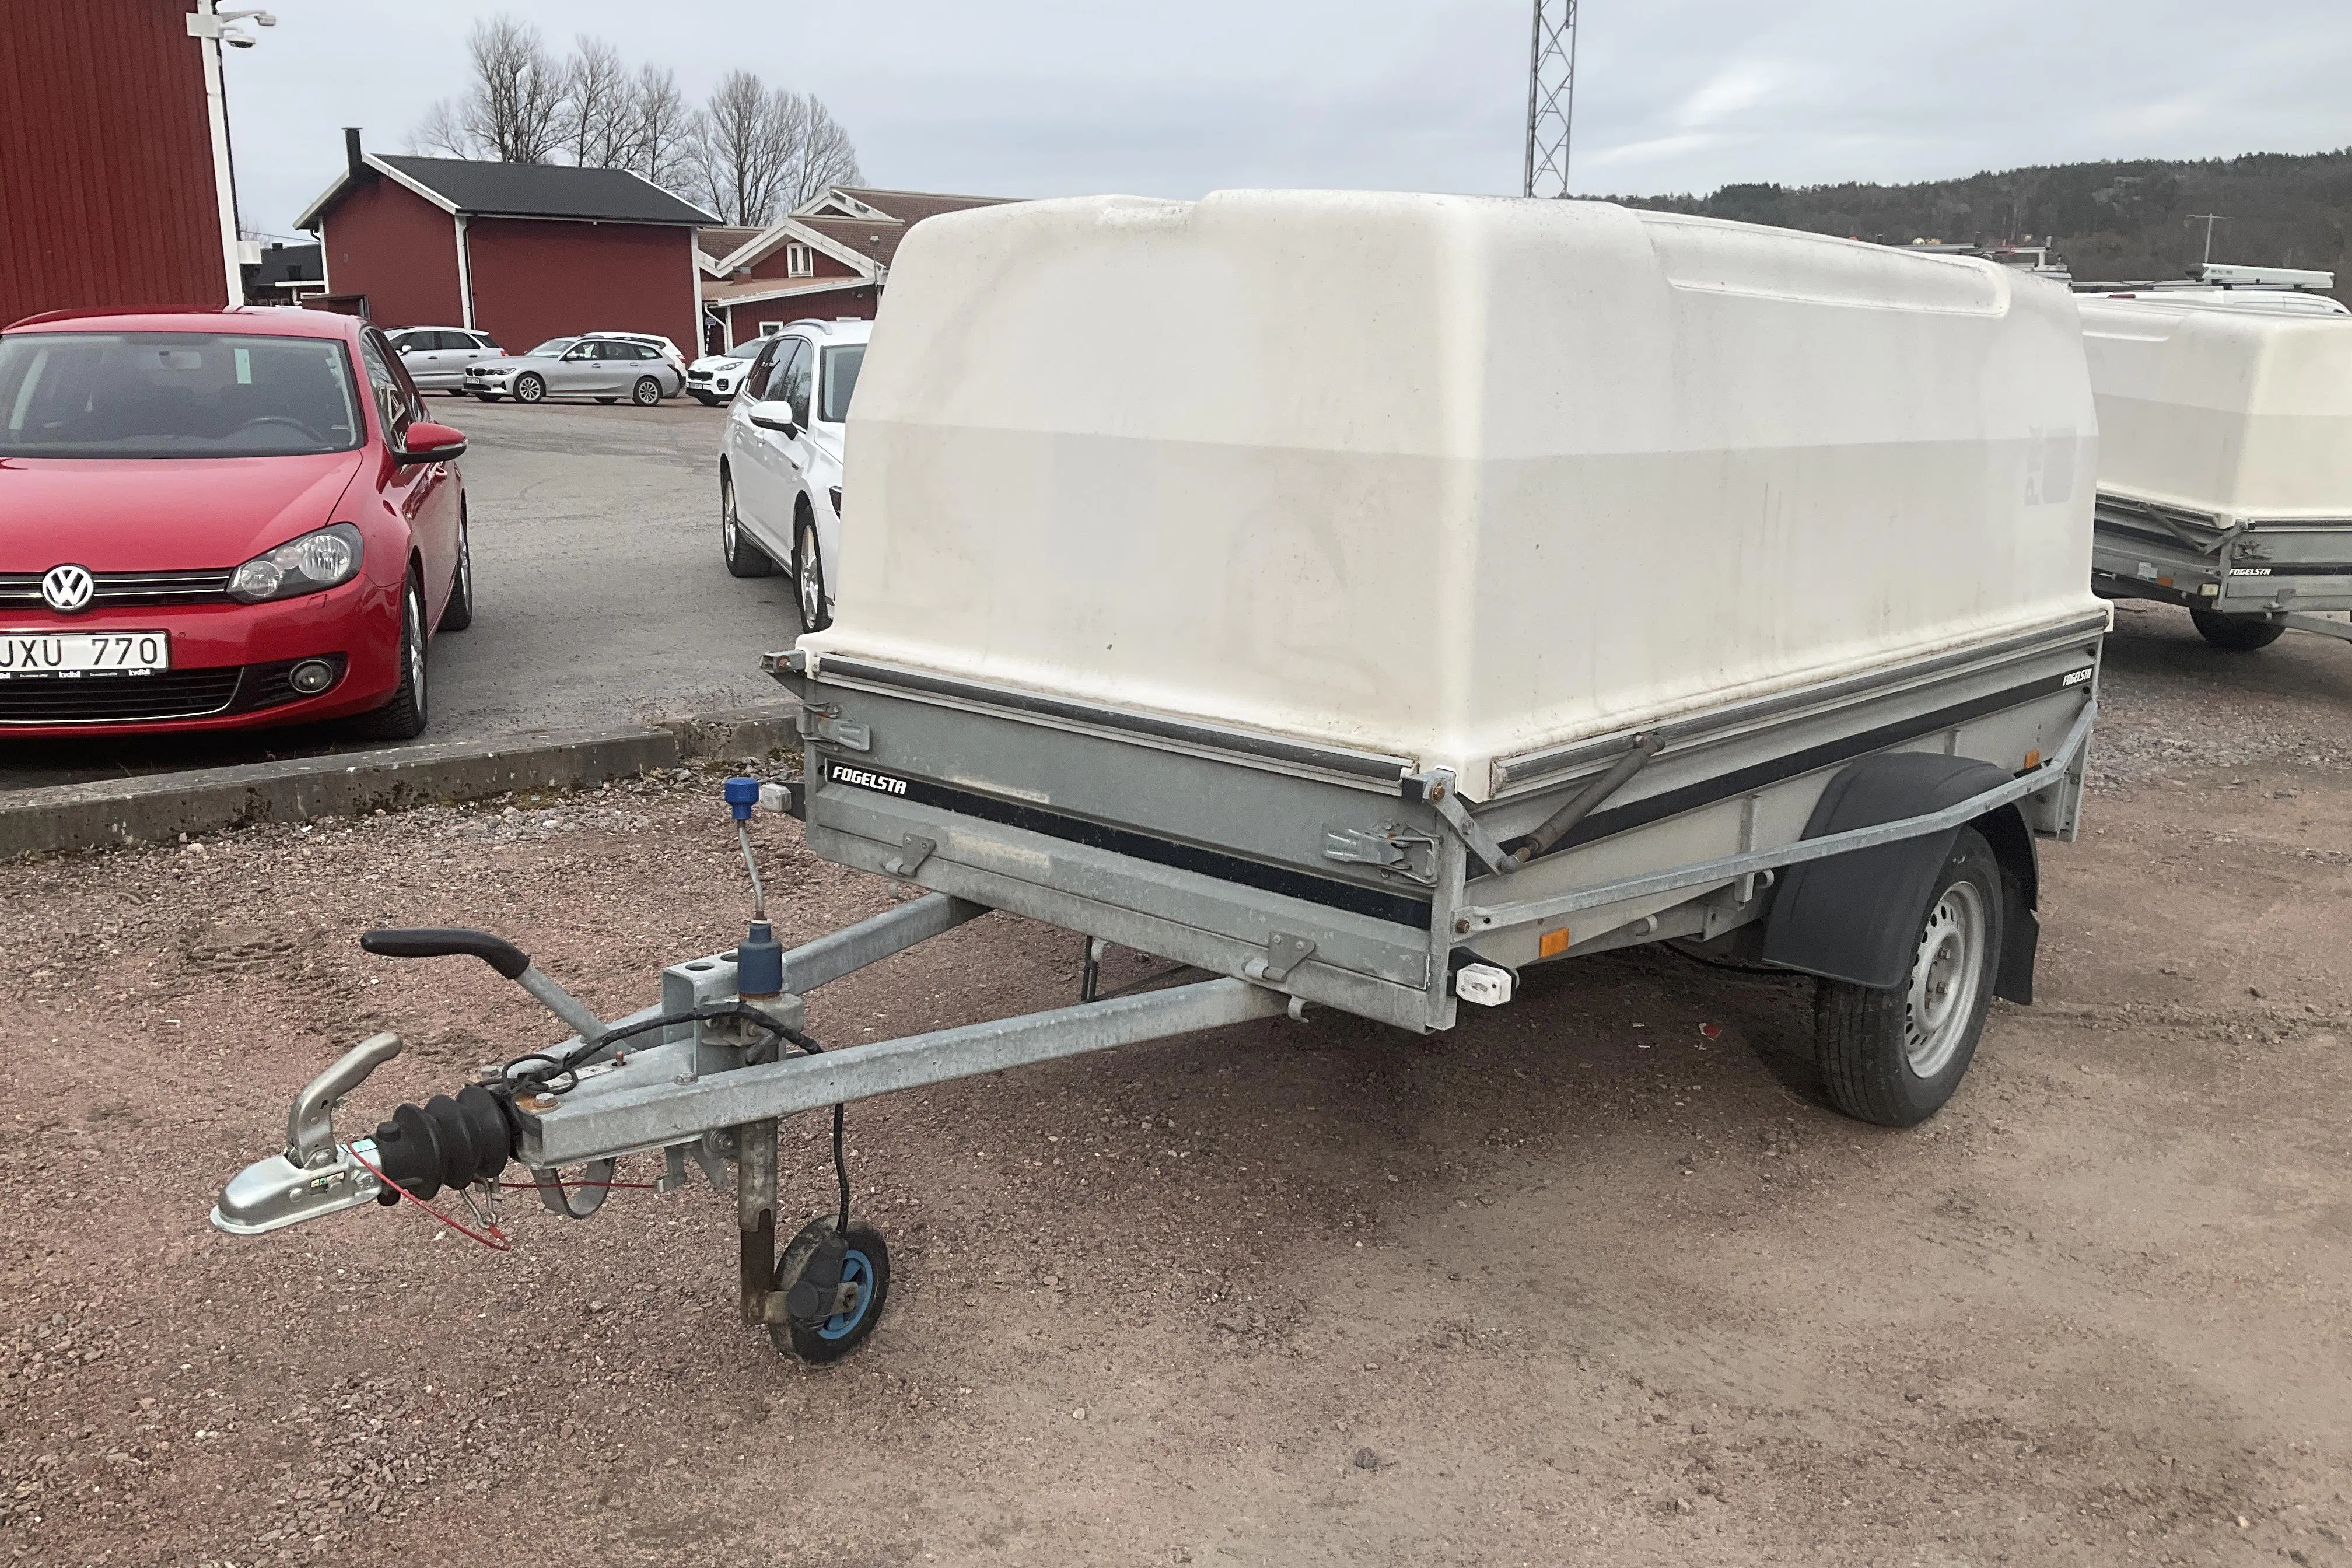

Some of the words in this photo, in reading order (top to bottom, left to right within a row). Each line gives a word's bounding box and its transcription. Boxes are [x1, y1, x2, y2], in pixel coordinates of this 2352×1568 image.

[43, 566, 93, 609] VW
[92, 638, 156, 666] 770
[2062, 668, 2092, 687] FOGELSTA
[832, 766, 907, 794] FOGELSTA
